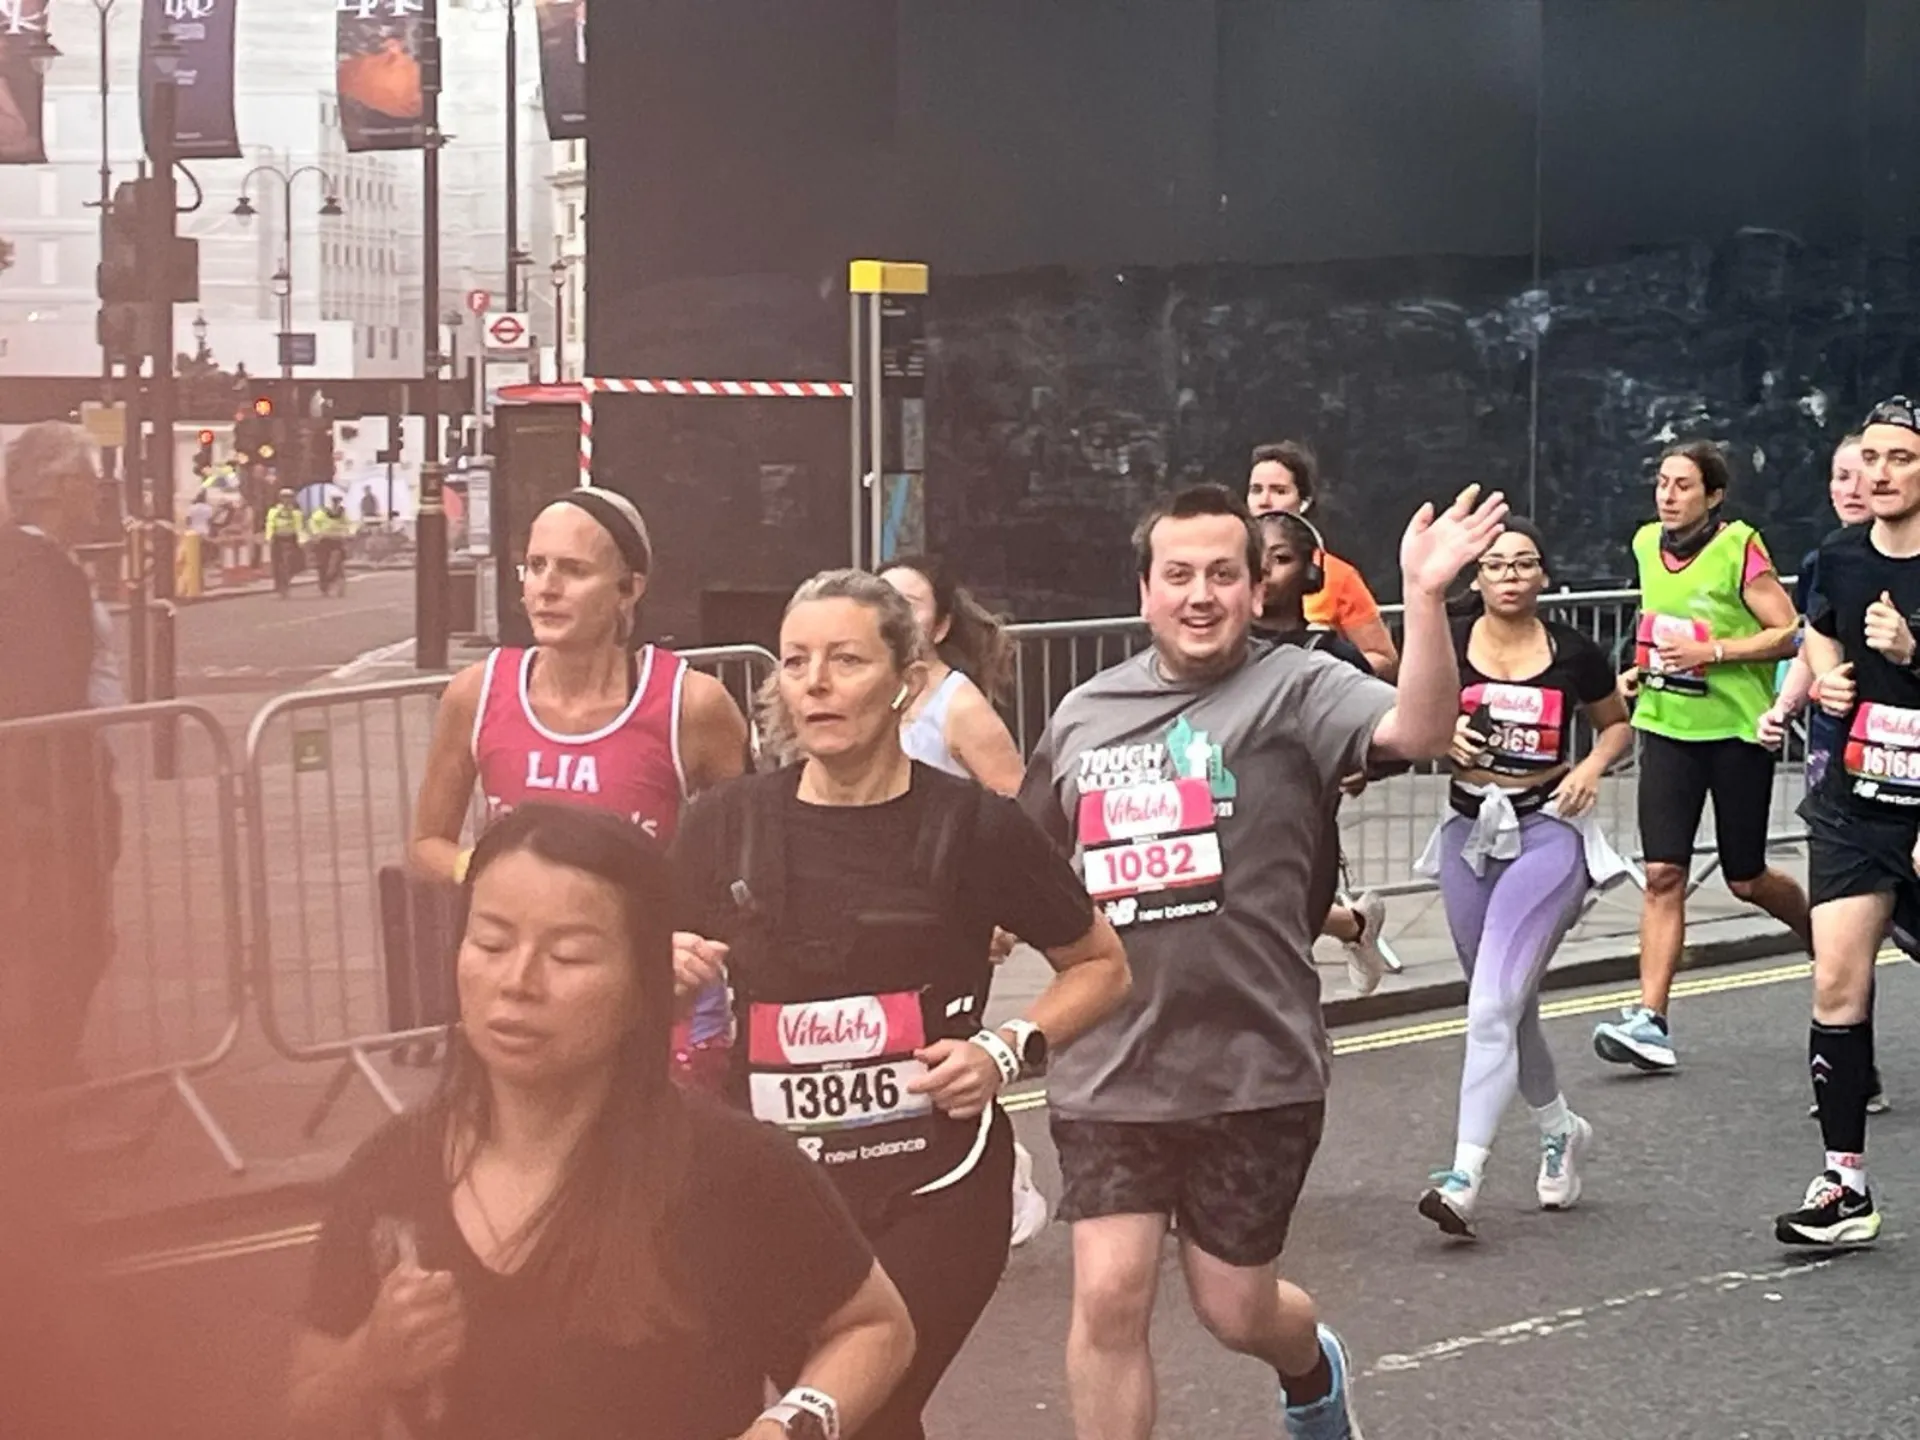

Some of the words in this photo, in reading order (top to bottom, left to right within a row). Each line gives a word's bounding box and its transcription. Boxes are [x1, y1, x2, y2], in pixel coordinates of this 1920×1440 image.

[525, 750, 599, 793] LIA
[1106, 791, 1179, 825] Vitality
[1103, 842, 1196, 885] 1082
[783, 1008, 882, 1053] Vitality
[779, 1067, 899, 1120] 13846
[824, 1148, 858, 1164] new
[860, 1137, 927, 1159] balance
